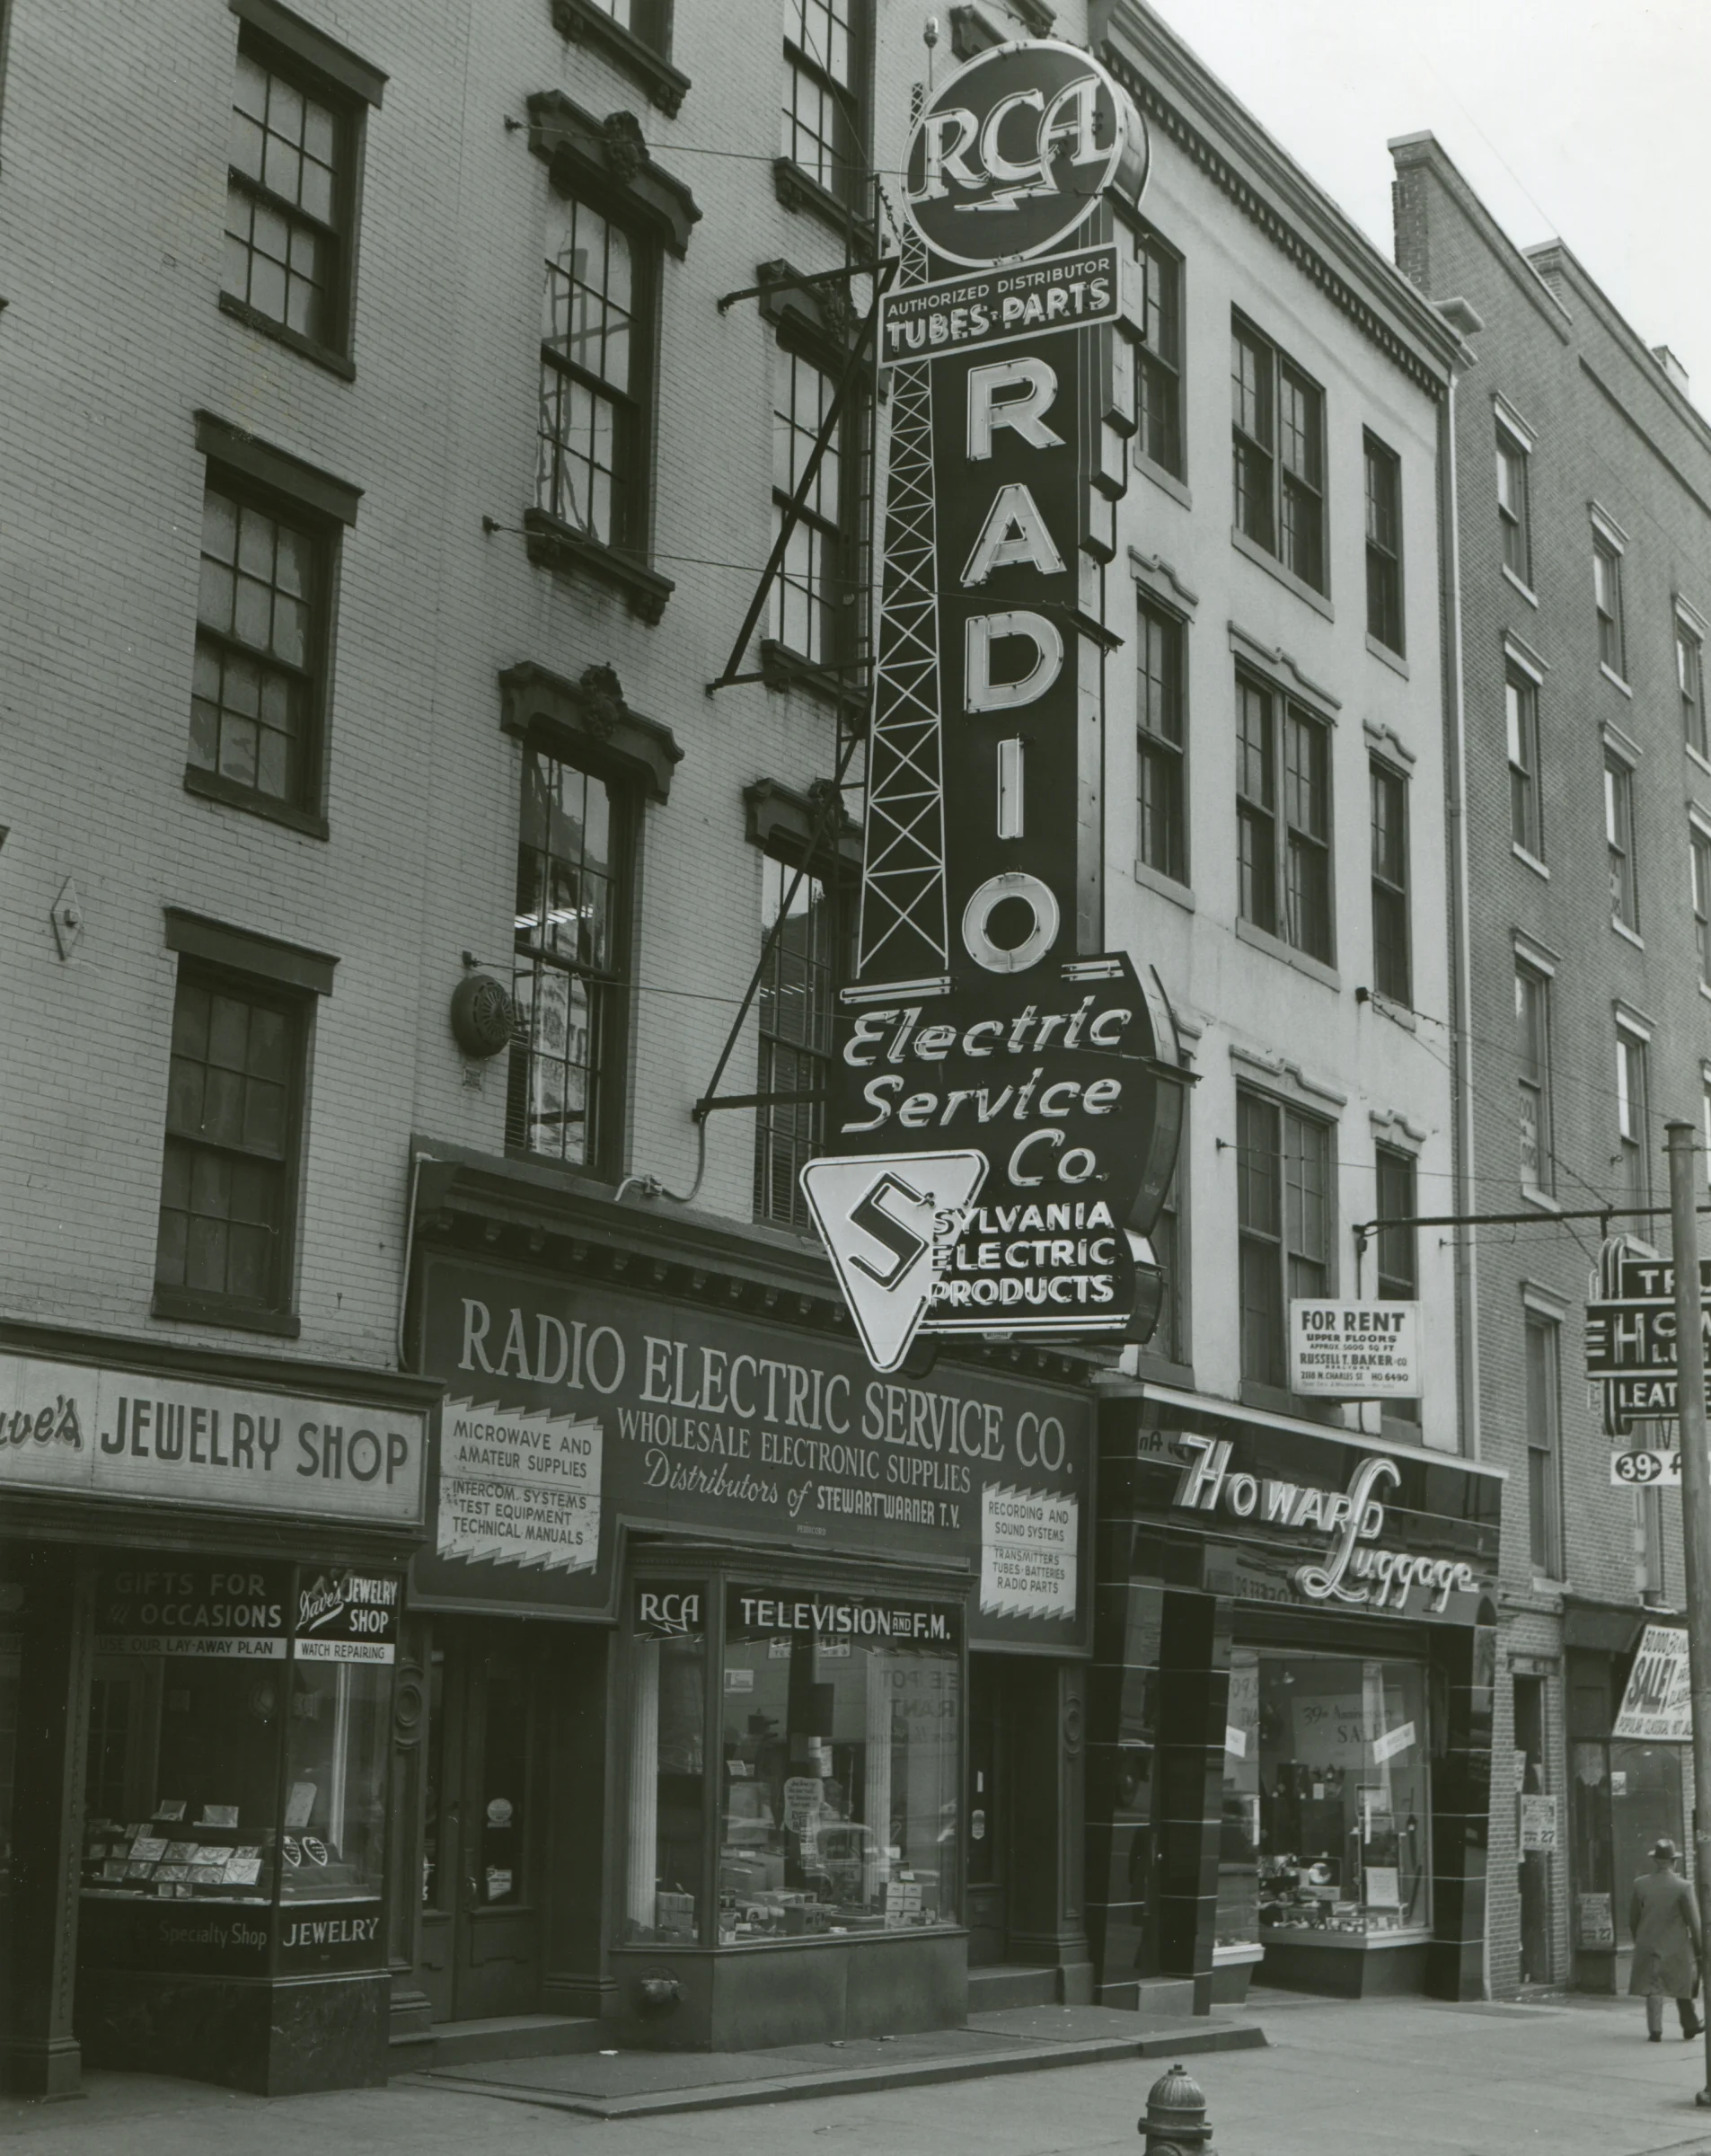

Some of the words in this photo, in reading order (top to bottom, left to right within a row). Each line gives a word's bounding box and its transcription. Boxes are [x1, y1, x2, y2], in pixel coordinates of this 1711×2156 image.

[905, 74, 1114, 205] RCA
[887, 284, 990, 317] AUTHORIZED
[997, 258, 1110, 293] DISTRIBUTOR
[886, 304, 989, 353] TUBES
[1002, 277, 1111, 329] PARTS
[961, 357, 1069, 974] RADIO
[842, 995, 1133, 1067] Electric
[841, 1067, 1123, 1134] Service
[932, 1200, 1115, 1236] SYLVANIA
[930, 1238, 1116, 1272] ELECTRIC
[927, 1274, 1115, 1308] PRODUCTS
[1301, 1311, 1336, 1330] FOR
[1344, 1312, 1406, 1332] RENT
[1345, 1334, 1397, 1343] FLOORS
[1300, 1353, 1340, 1365] RUSSELL
[1351, 1354, 1393, 1365] BAKER
[458, 1298, 625, 1394] RADIO
[639, 1335, 851, 1435] ELECTRIC
[861, 1381, 1005, 1462] SERVICE
[1015, 1411, 1073, 1474] CO.
[1326, 1372, 1354, 1381] CHARLES
[1385, 1374, 1408, 1382] 6490
[101, 1397, 280, 1471] JEWELRY
[296, 1422, 409, 1484] SHOP
[454, 1419, 551, 1451] MICROWAVE
[560, 1436, 592, 1456] AND
[617, 1407, 752, 1460] WHOLESALE
[761, 1431, 880, 1480] ELECTRONIC
[886, 1454, 971, 1494] SUPPLIES
[459, 1445, 520, 1469] AMATEUR
[527, 1454, 587, 1479] SUPPLIES
[524, 1489, 587, 1510] SYSTEMS
[643, 1447, 780, 1505] Distributors
[787, 1480, 813, 1518] of
[939, 1502, 960, 1529] T.V.
[1173, 1432, 1384, 1539] HOWARD
[458, 1498, 490, 1515] TEST
[495, 1503, 572, 1526] EQUIPMENT
[989, 1500, 1044, 1521] RECORDING
[1048, 1509, 1069, 1524] AND
[453, 1515, 521, 1539] TECHNICAL
[525, 1524, 584, 1546] MANUALS
[995, 1521, 1025, 1537] SOUND
[1027, 1524, 1064, 1542] SYSTEMS
[992, 1561, 1020, 1575] TUBES
[1025, 1565, 1065, 1580] BATTERIES
[994, 1547, 1060, 1566] TRANSMITTERS
[115, 1571, 194, 1595] GIFTS
[210, 1573, 266, 1596] FOR
[997, 1576, 1027, 1591] RADIO
[1029, 1579, 1059, 1595] PARTS
[140, 1603, 282, 1629] OCCASIONS
[295, 1580, 343, 1630] Dave's
[345, 1577, 397, 1605] JEWELRY
[639, 1593, 700, 1622] RCA
[740, 1598, 891, 1636] TELEVISION
[893, 1617, 912, 1632] AND
[913, 1613, 951, 1640] F.M.
[349, 1608, 389, 1633] SHOP
[99, 1639, 126, 1653] USE
[131, 1639, 161, 1653] OUR
[167, 1639, 233, 1654] LAY-AWAY
[237, 1641, 274, 1655] PLAN
[301, 1642, 331, 1657] WATCH
[334, 1644, 384, 1659] REPAIRING
[1625, 1655, 1678, 1715] SALE!
[159, 1921, 227, 1948] Specialty
[232, 1922, 268, 1950] Shop
[283, 1917, 380, 1948] JEWELRY
